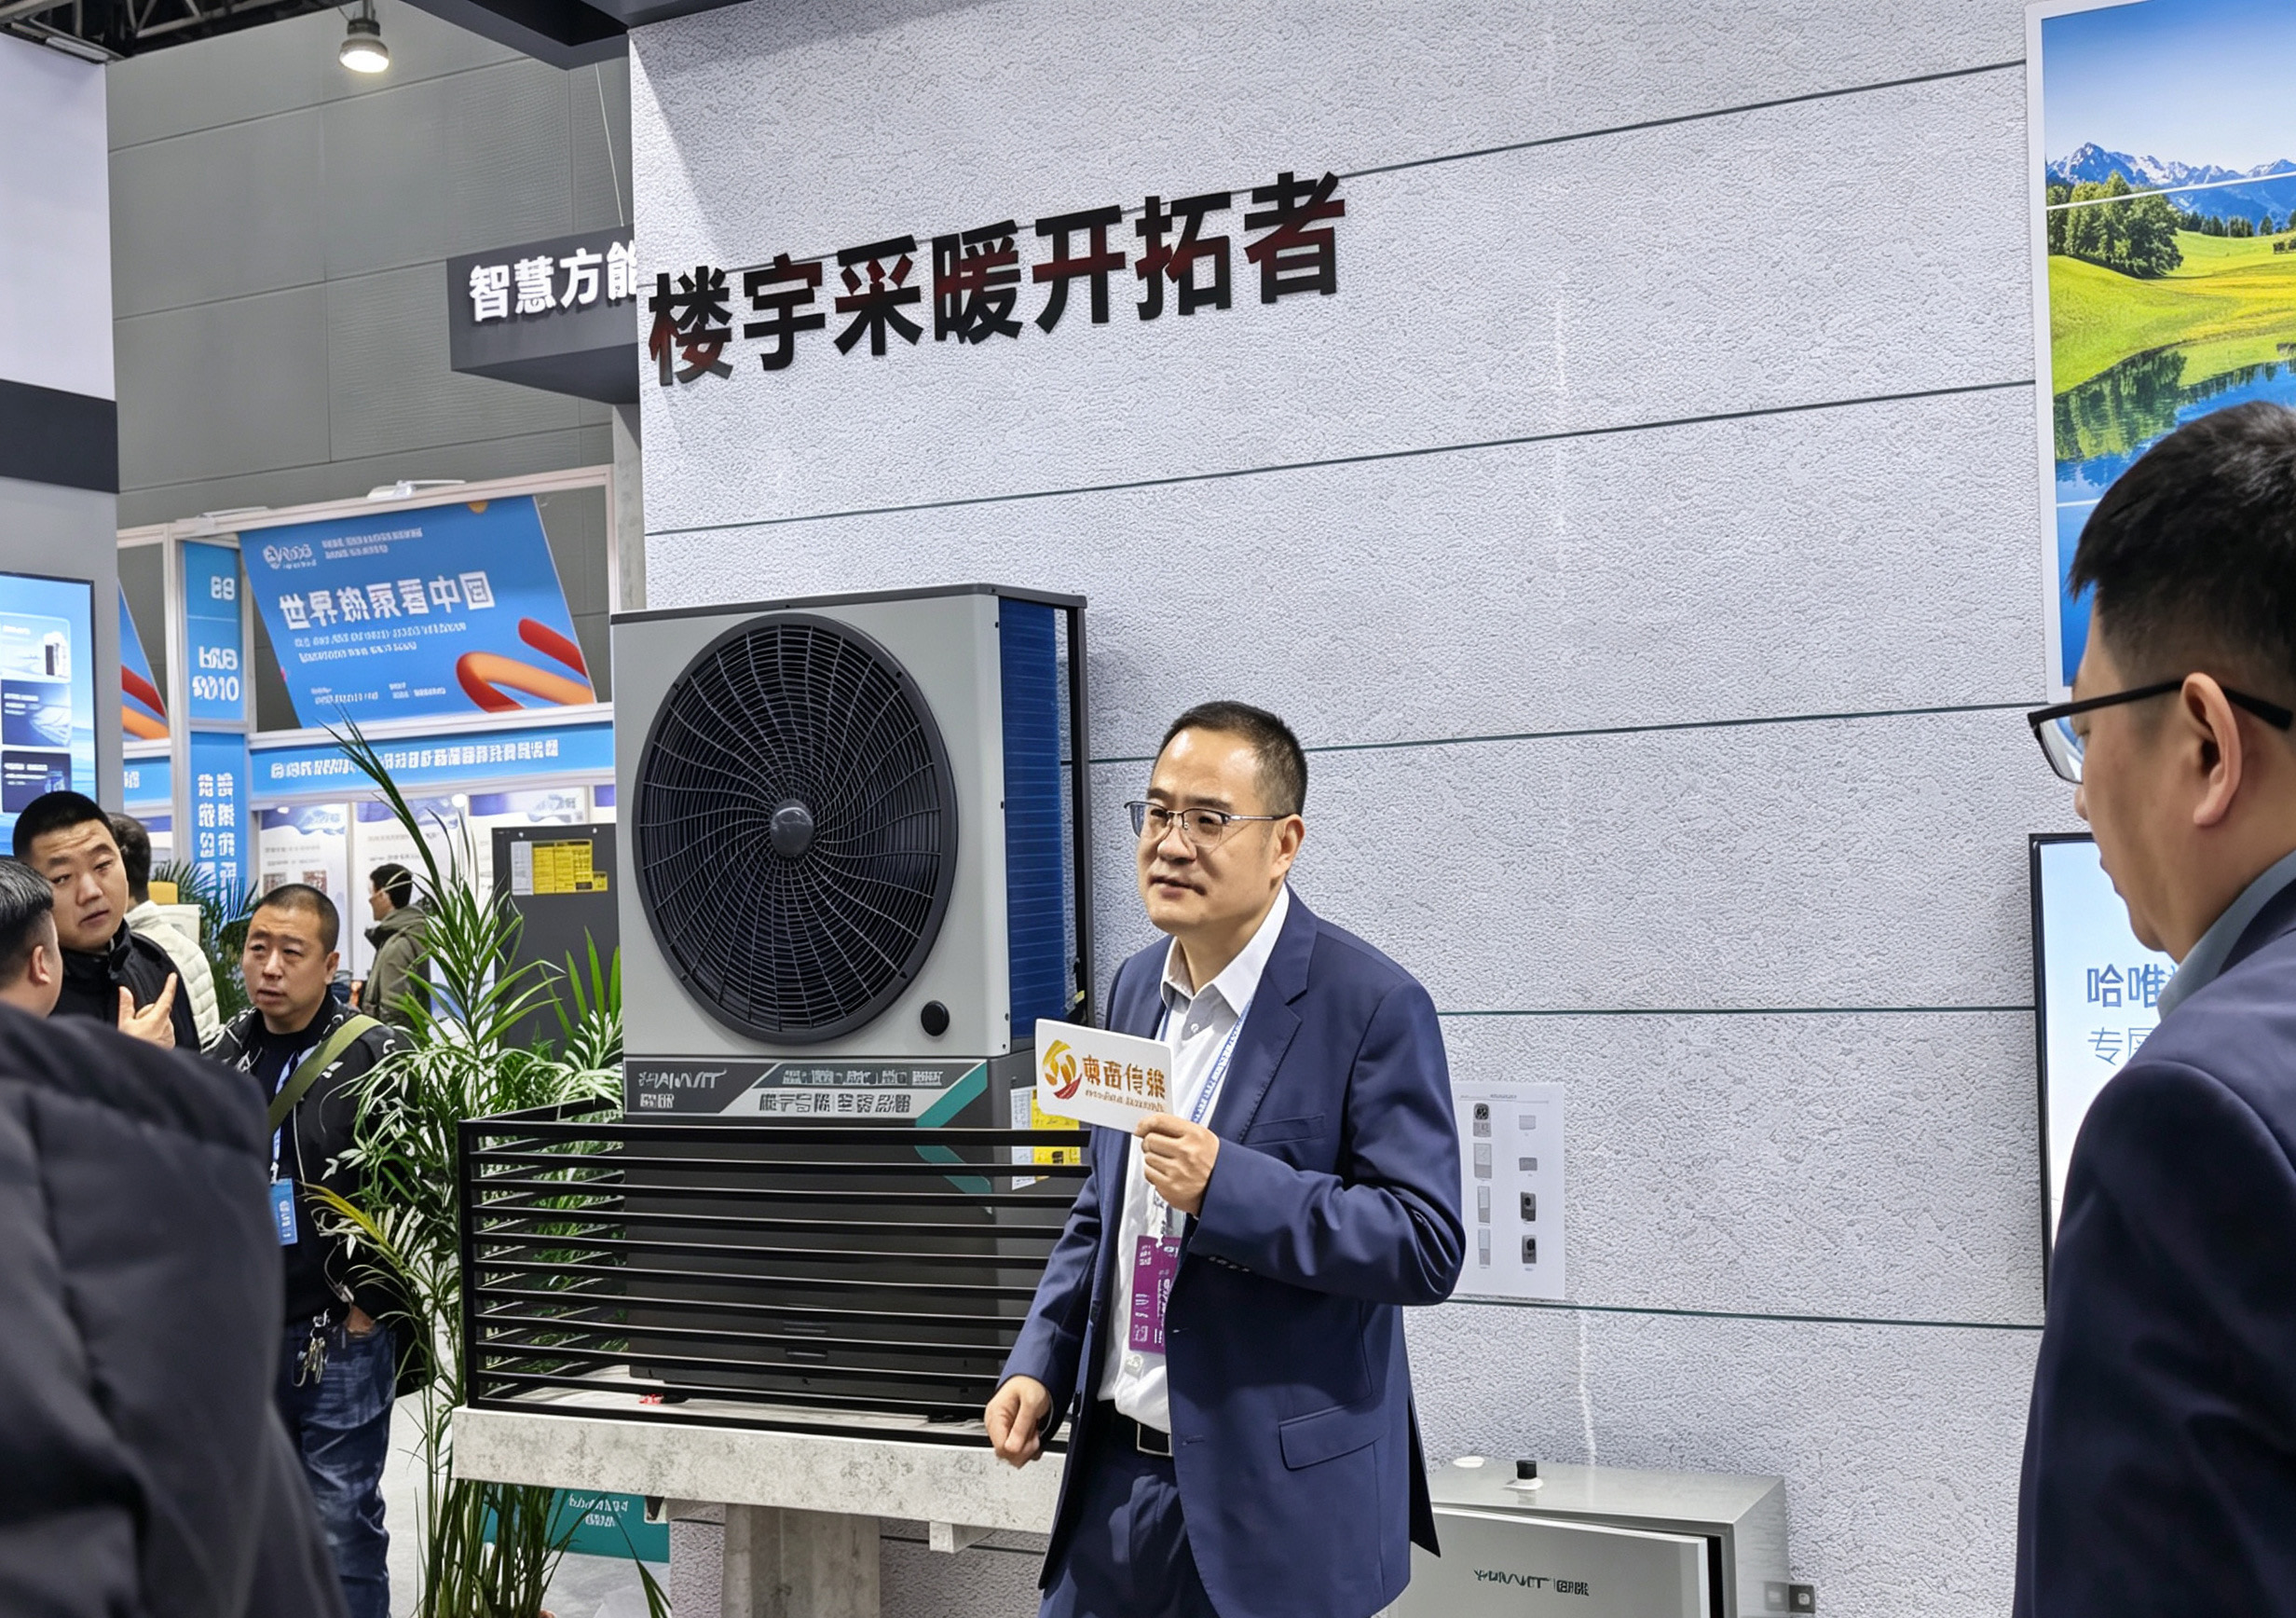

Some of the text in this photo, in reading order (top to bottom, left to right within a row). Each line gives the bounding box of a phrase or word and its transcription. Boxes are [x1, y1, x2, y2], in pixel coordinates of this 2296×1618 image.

[648, 171, 1346, 387] 楼宇采暖开拓者
[2086, 963, 2178, 1008] 哈唯
